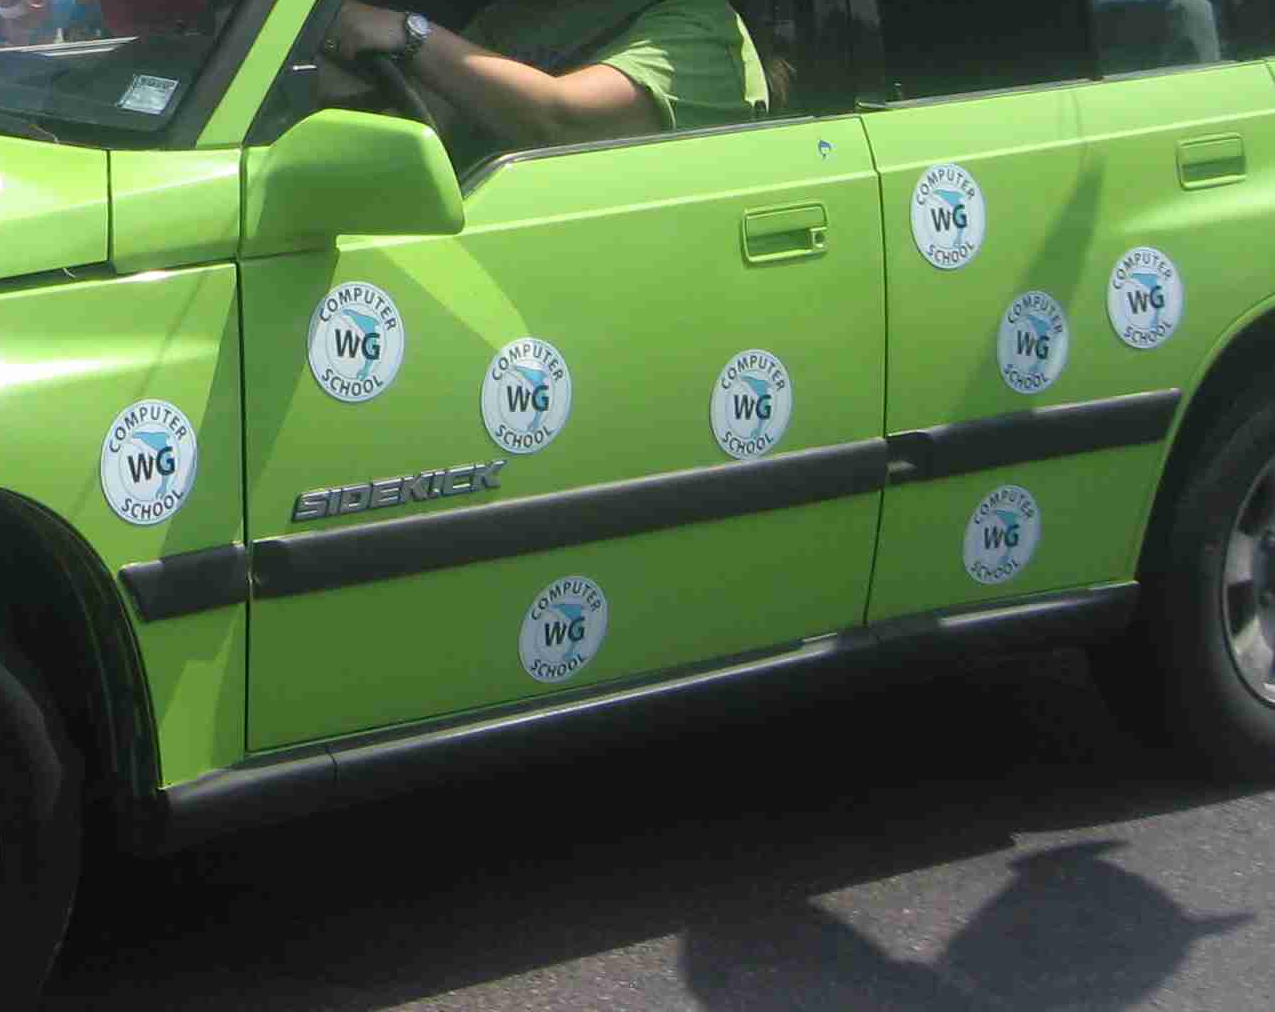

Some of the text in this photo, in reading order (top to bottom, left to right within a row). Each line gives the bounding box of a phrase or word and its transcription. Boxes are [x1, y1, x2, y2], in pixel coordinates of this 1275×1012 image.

[917, 169, 975, 205] COMPUTER
[931, 204, 967, 232] WG
[928, 242, 975, 263] SCHOOL
[1113, 253, 1172, 290] COMPUTER
[319, 287, 397, 330] COMPUTER
[1008, 295, 1063, 333] COMPUTER
[1127, 285, 1165, 314] WG
[335, 329, 381, 360] WG
[1017, 330, 1050, 359] WG
[1124, 321, 1172, 342] SCHOOL
[492, 344, 564, 382] COMPUTER
[721, 355, 785, 391] COMPUTER
[322, 368, 383, 396] SCHOOL
[507, 385, 549, 412] WG
[734, 394, 771, 420] WG
[109, 406, 187, 453] COMPUTER
[495, 424, 553, 448] SCHOOL
[723, 431, 773, 453] SCHOOL
[127, 446, 176, 483] WG
[122, 490, 184, 519] SCHOOL
[292, 460, 507, 523] SIDEKICK
[985, 524, 1019, 550] WG
[532, 581, 601, 620] COMPUTER
[545, 617, 585, 646] WG
[531, 654, 585, 677] SCHOOL
